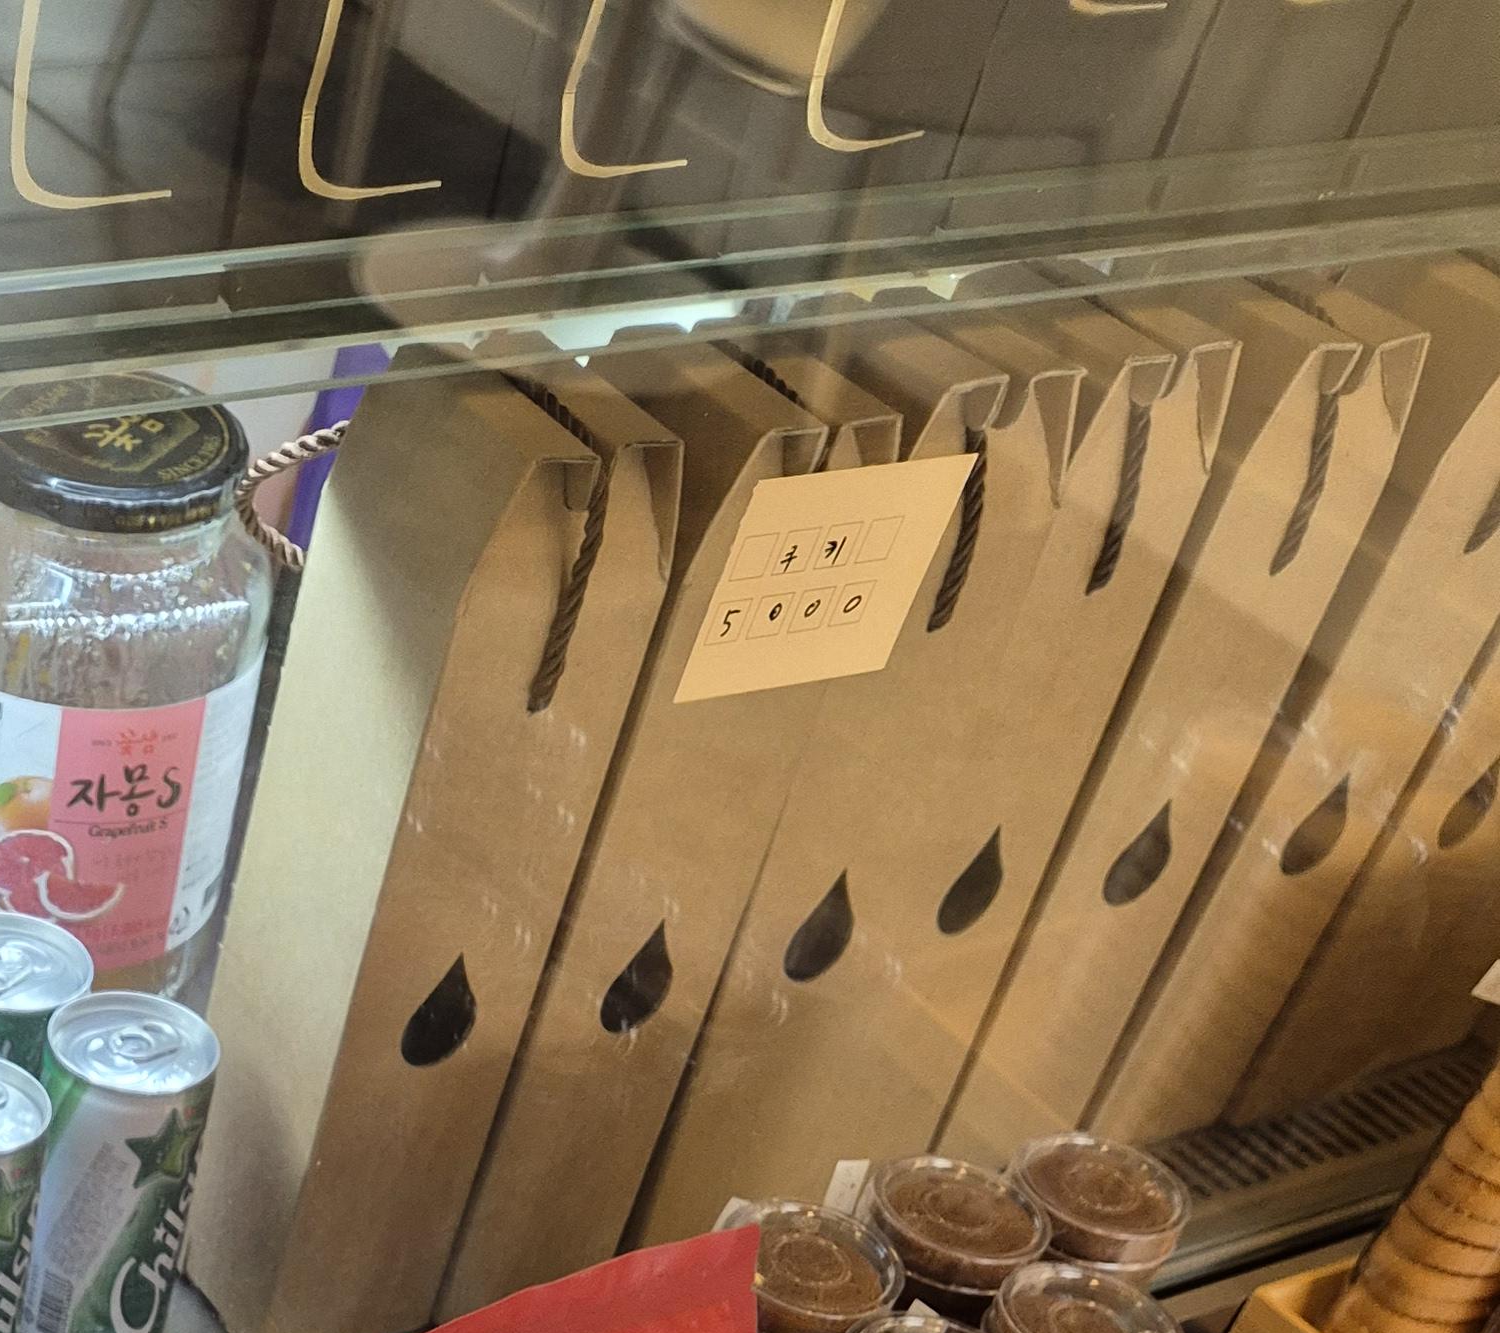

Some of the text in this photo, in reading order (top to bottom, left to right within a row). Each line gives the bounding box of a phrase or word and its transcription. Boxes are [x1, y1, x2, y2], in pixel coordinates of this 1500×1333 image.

[780, 536, 847, 573] 쿠키
[720, 595, 862, 637] 5000
[88, 821, 155, 839] Grapefruit
